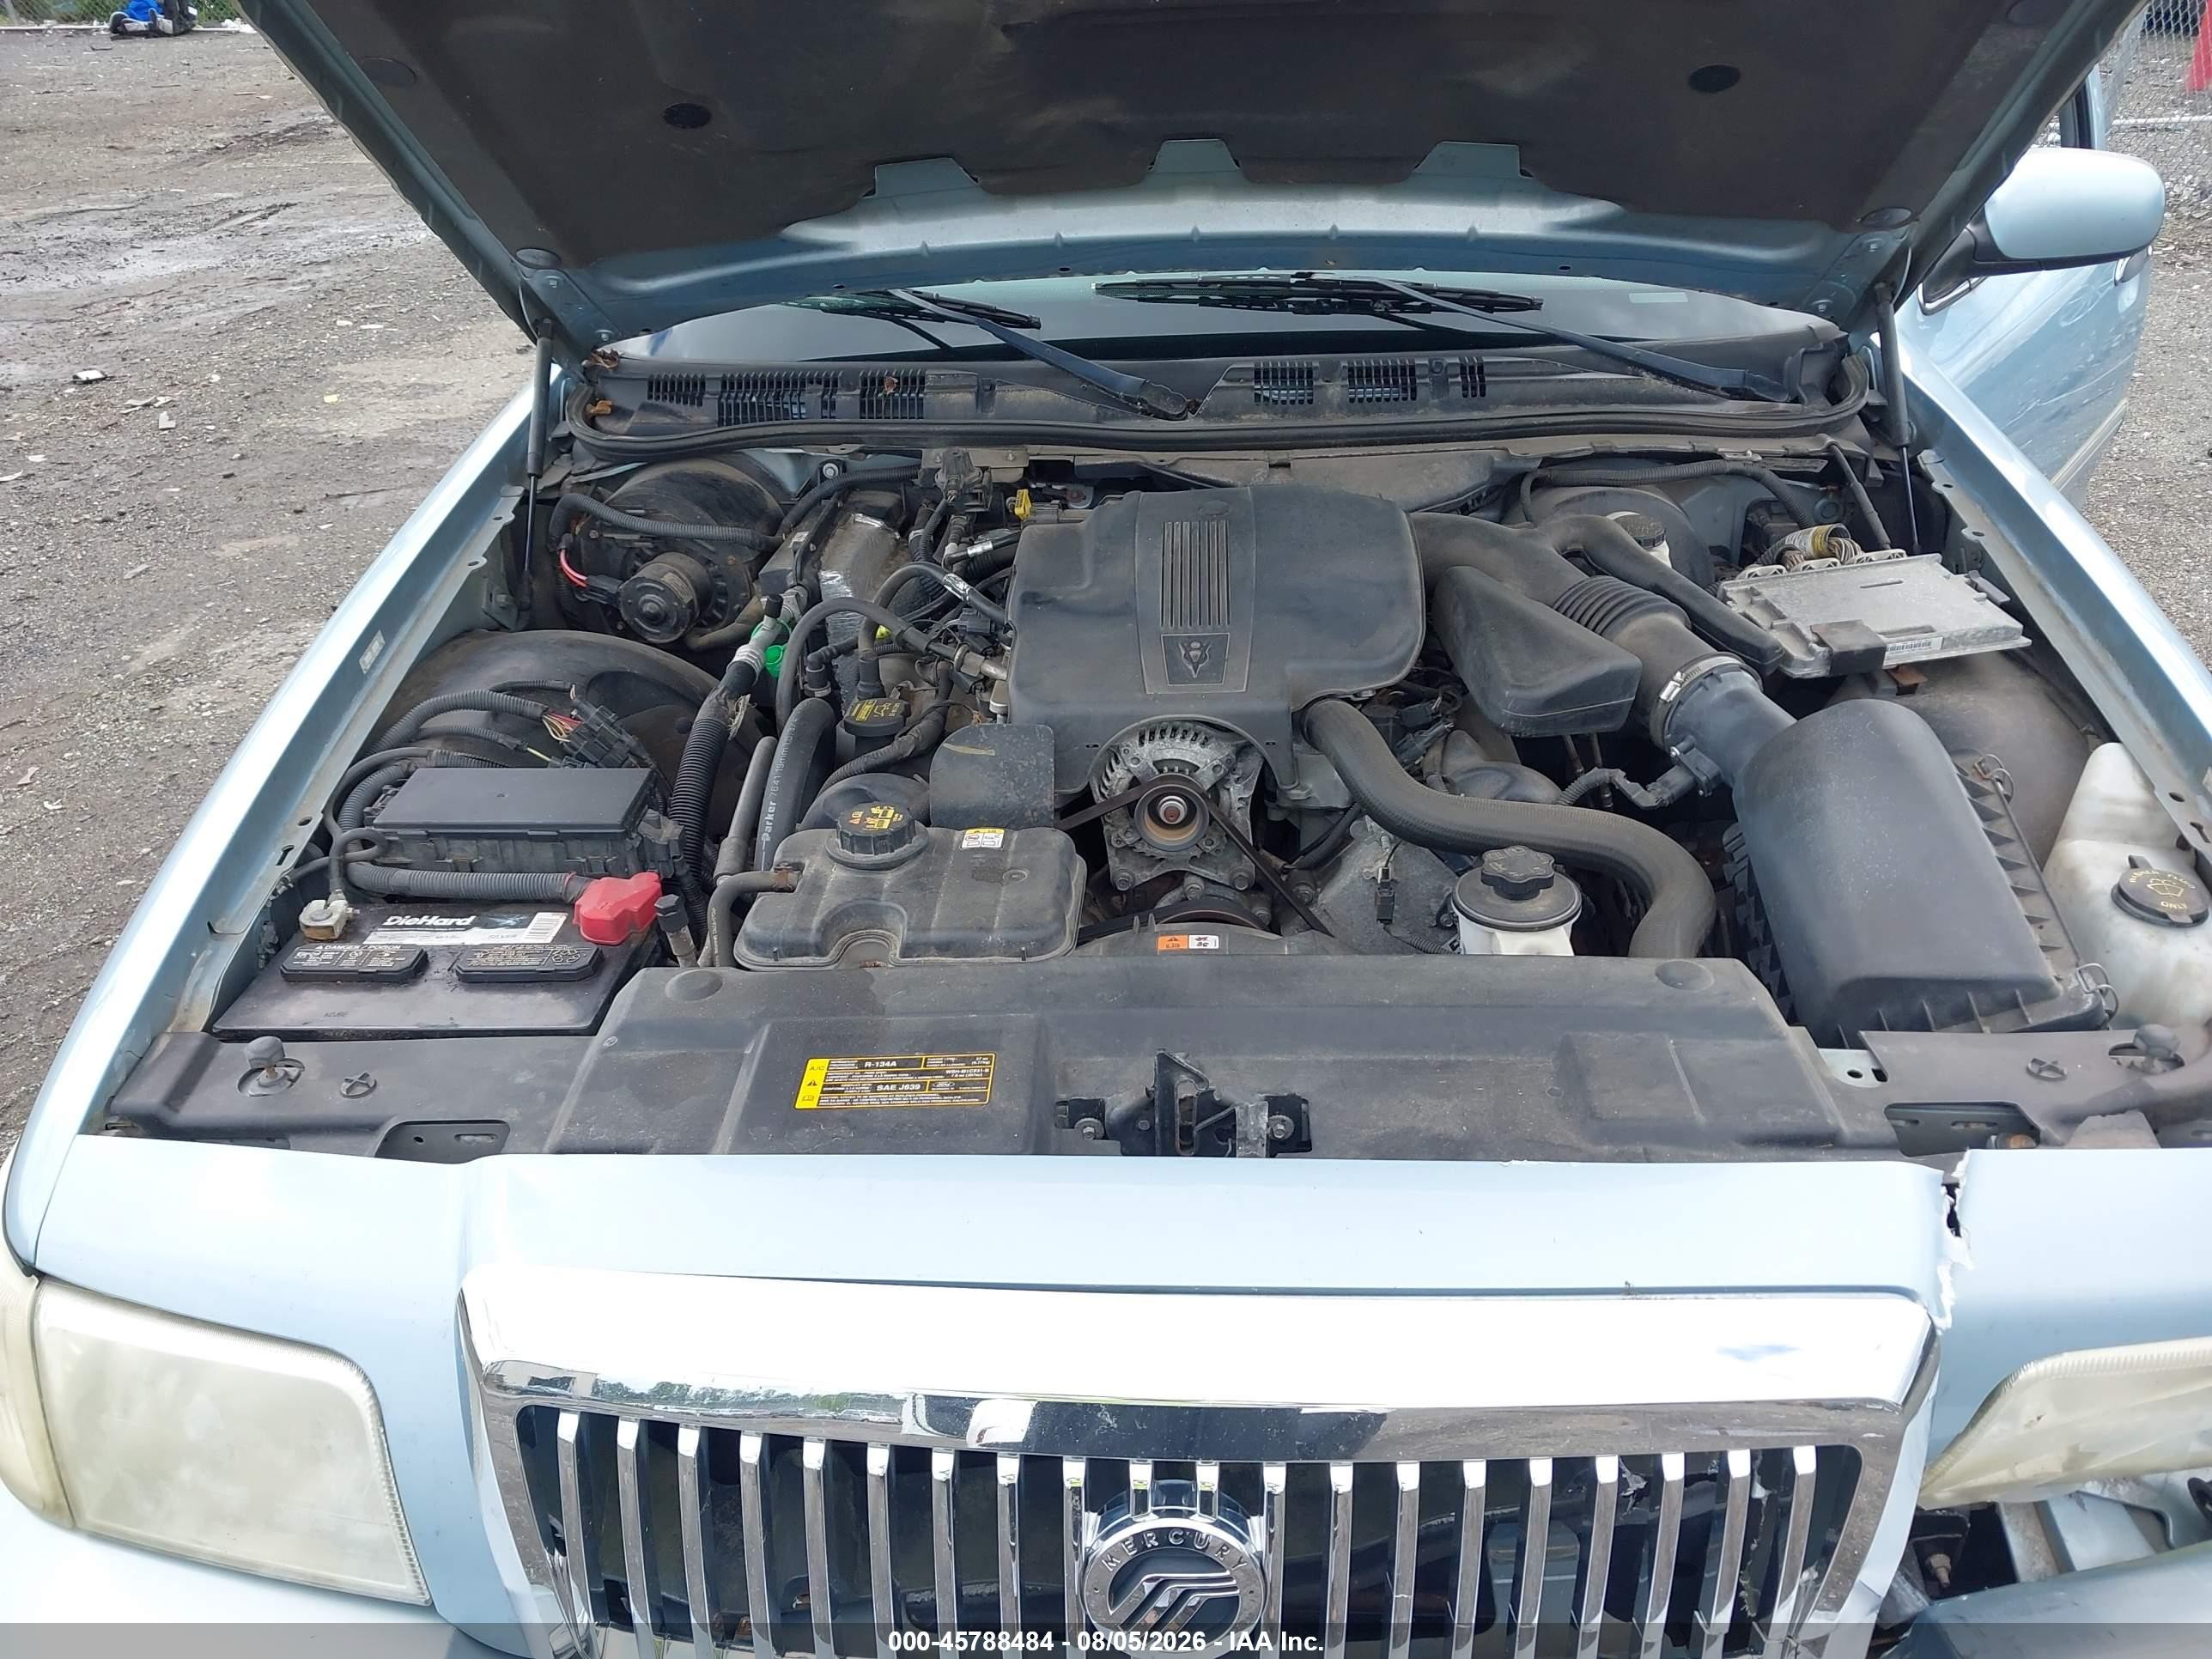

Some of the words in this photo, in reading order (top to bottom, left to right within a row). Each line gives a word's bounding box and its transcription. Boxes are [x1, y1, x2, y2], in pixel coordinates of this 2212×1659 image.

[762, 799, 777, 842] Parker
[382, 915, 477, 926] DieHard
[1102, 1528, 1248, 1572] MERCURY
